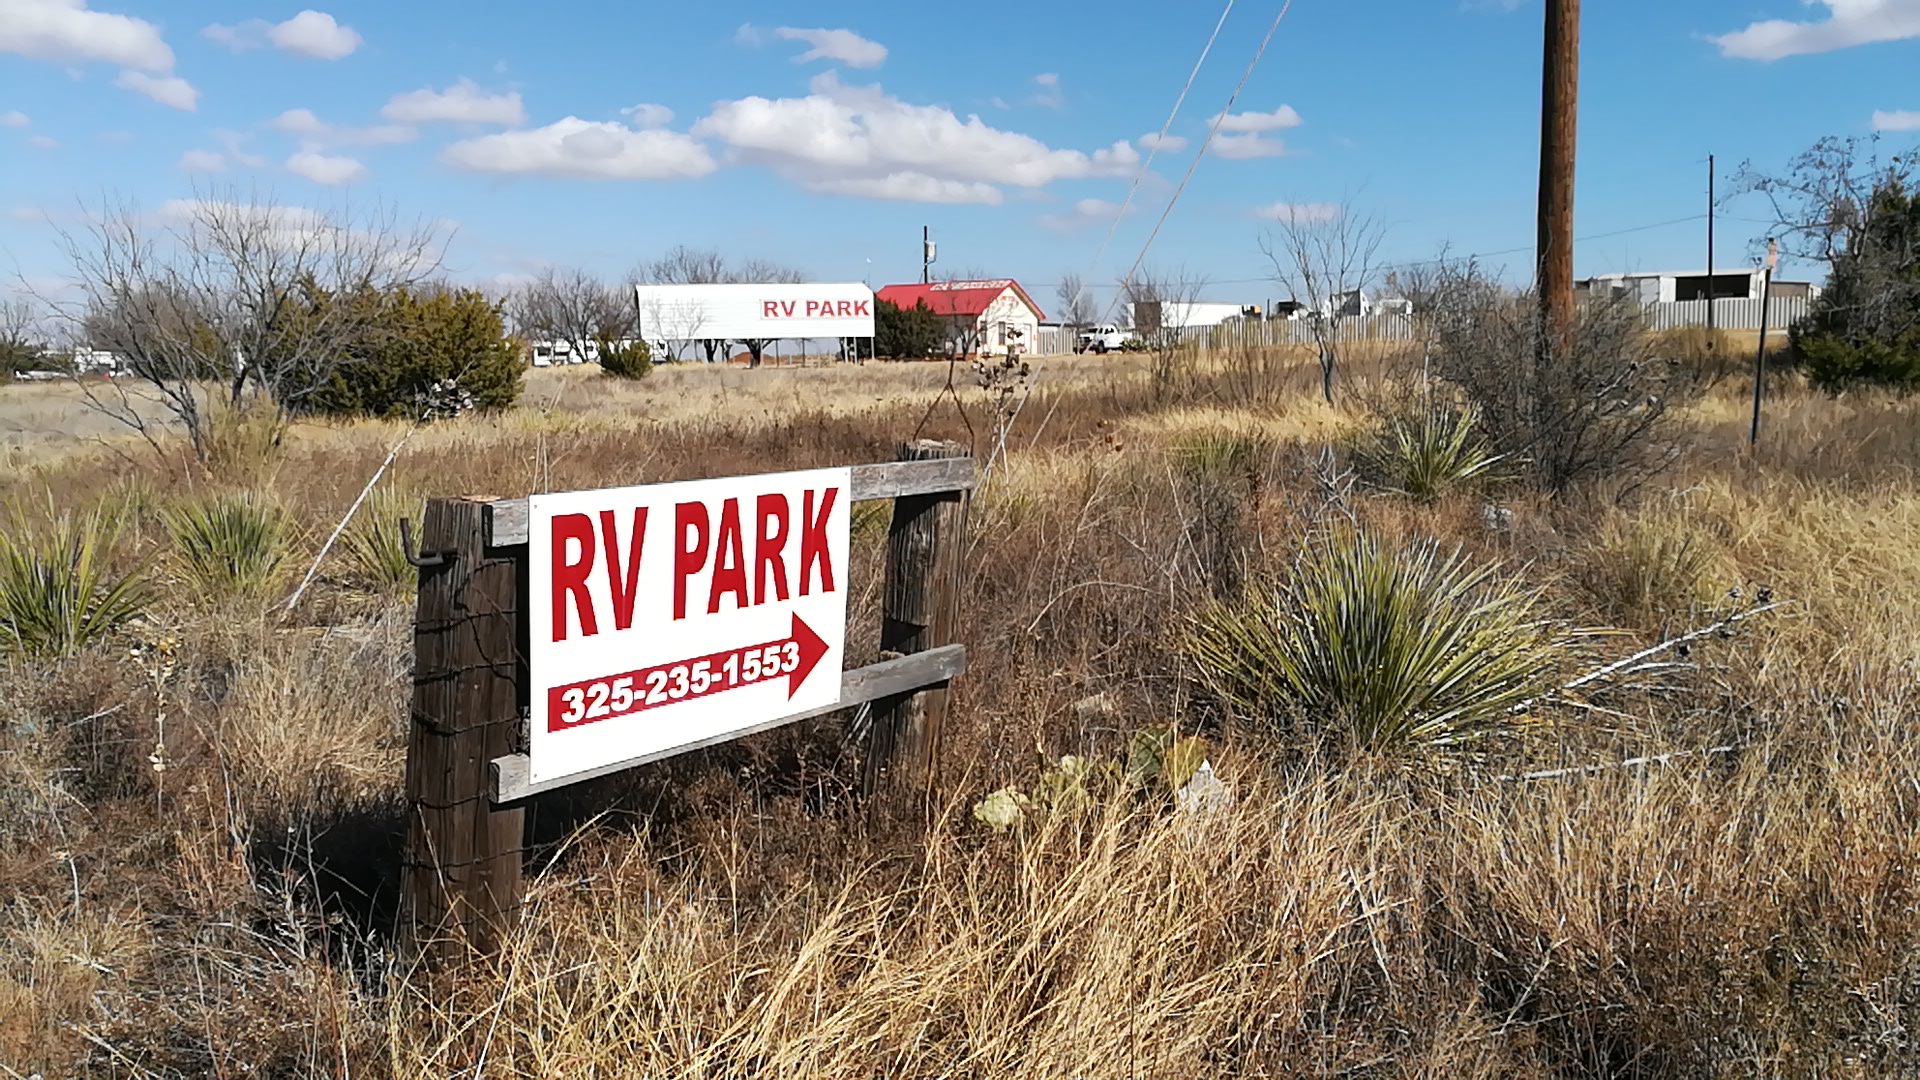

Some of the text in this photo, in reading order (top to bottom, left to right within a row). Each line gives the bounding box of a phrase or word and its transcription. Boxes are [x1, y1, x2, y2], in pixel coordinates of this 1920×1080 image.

[764, 301, 871, 317] RV PARK
[552, 488, 839, 642] RV PARK
[561, 641, 800, 723] 325-235-1553
